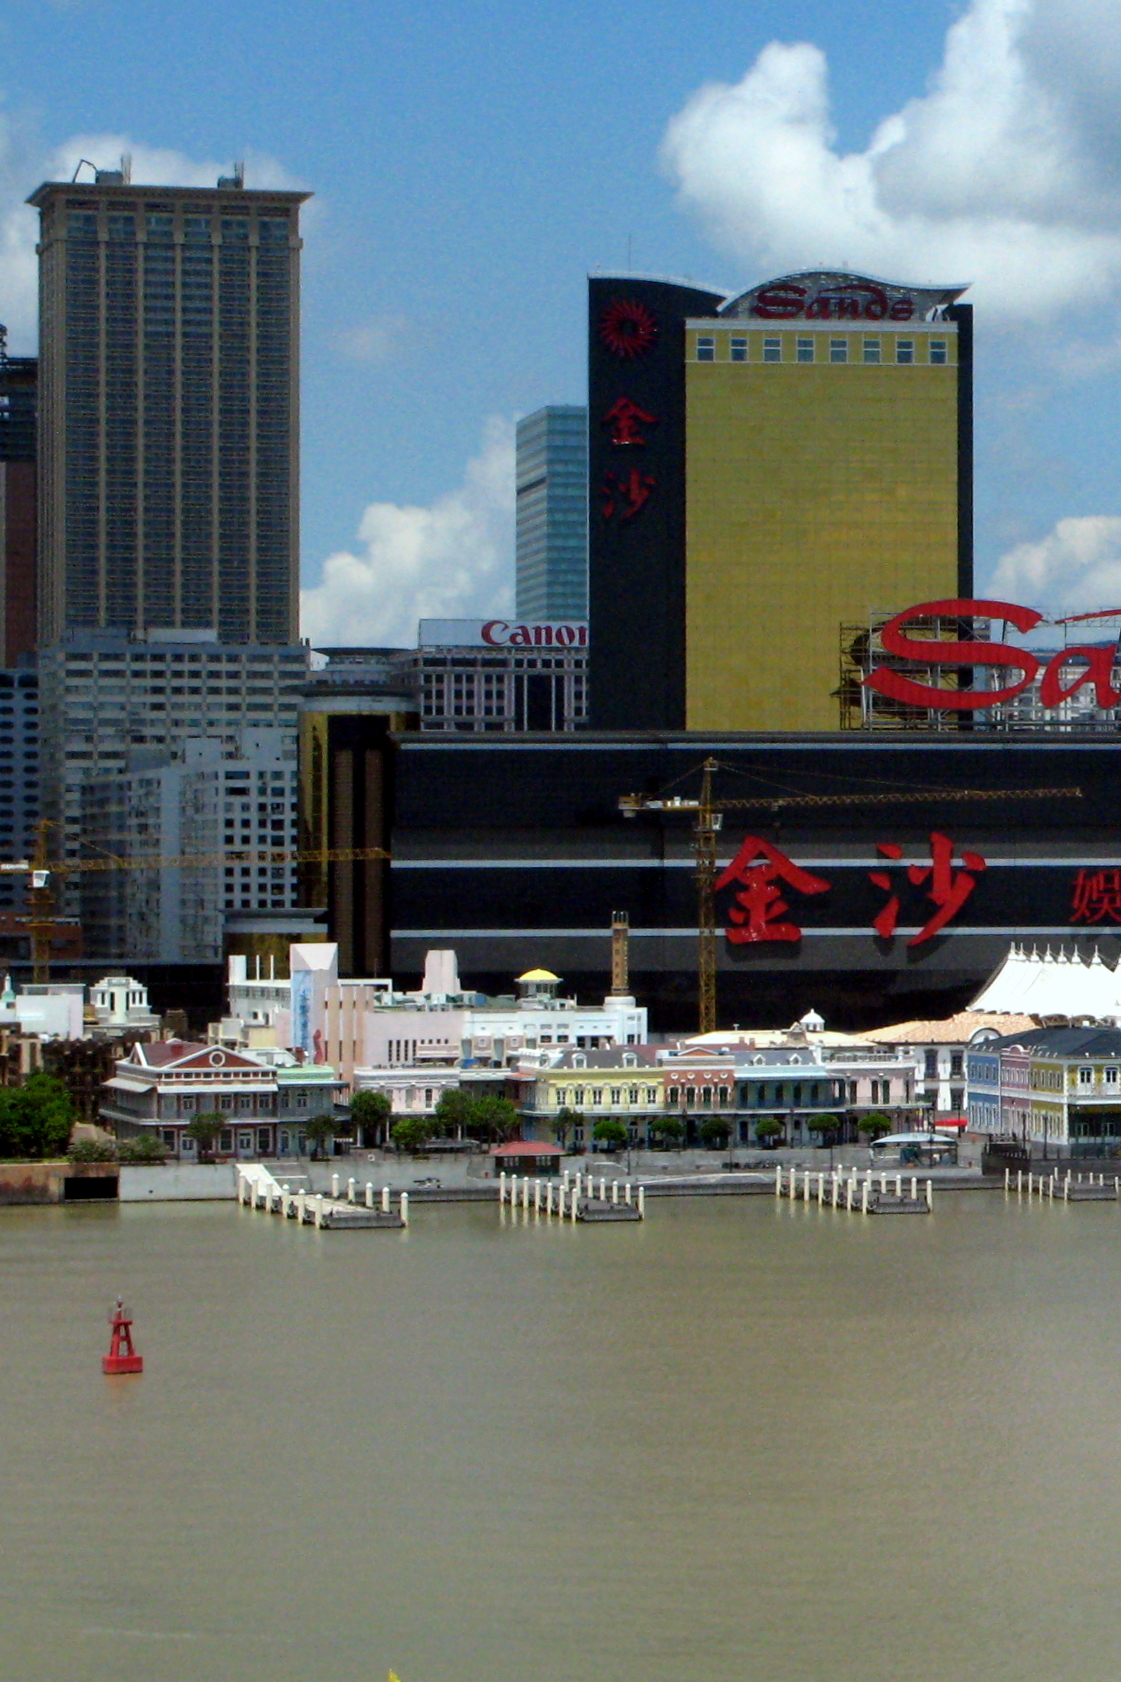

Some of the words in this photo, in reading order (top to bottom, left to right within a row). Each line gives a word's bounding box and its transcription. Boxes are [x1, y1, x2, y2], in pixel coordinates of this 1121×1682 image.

[751, 284, 914, 321] Sands
[601, 397, 658, 520] 金沙
[714, 832, 986, 946] 金沙
